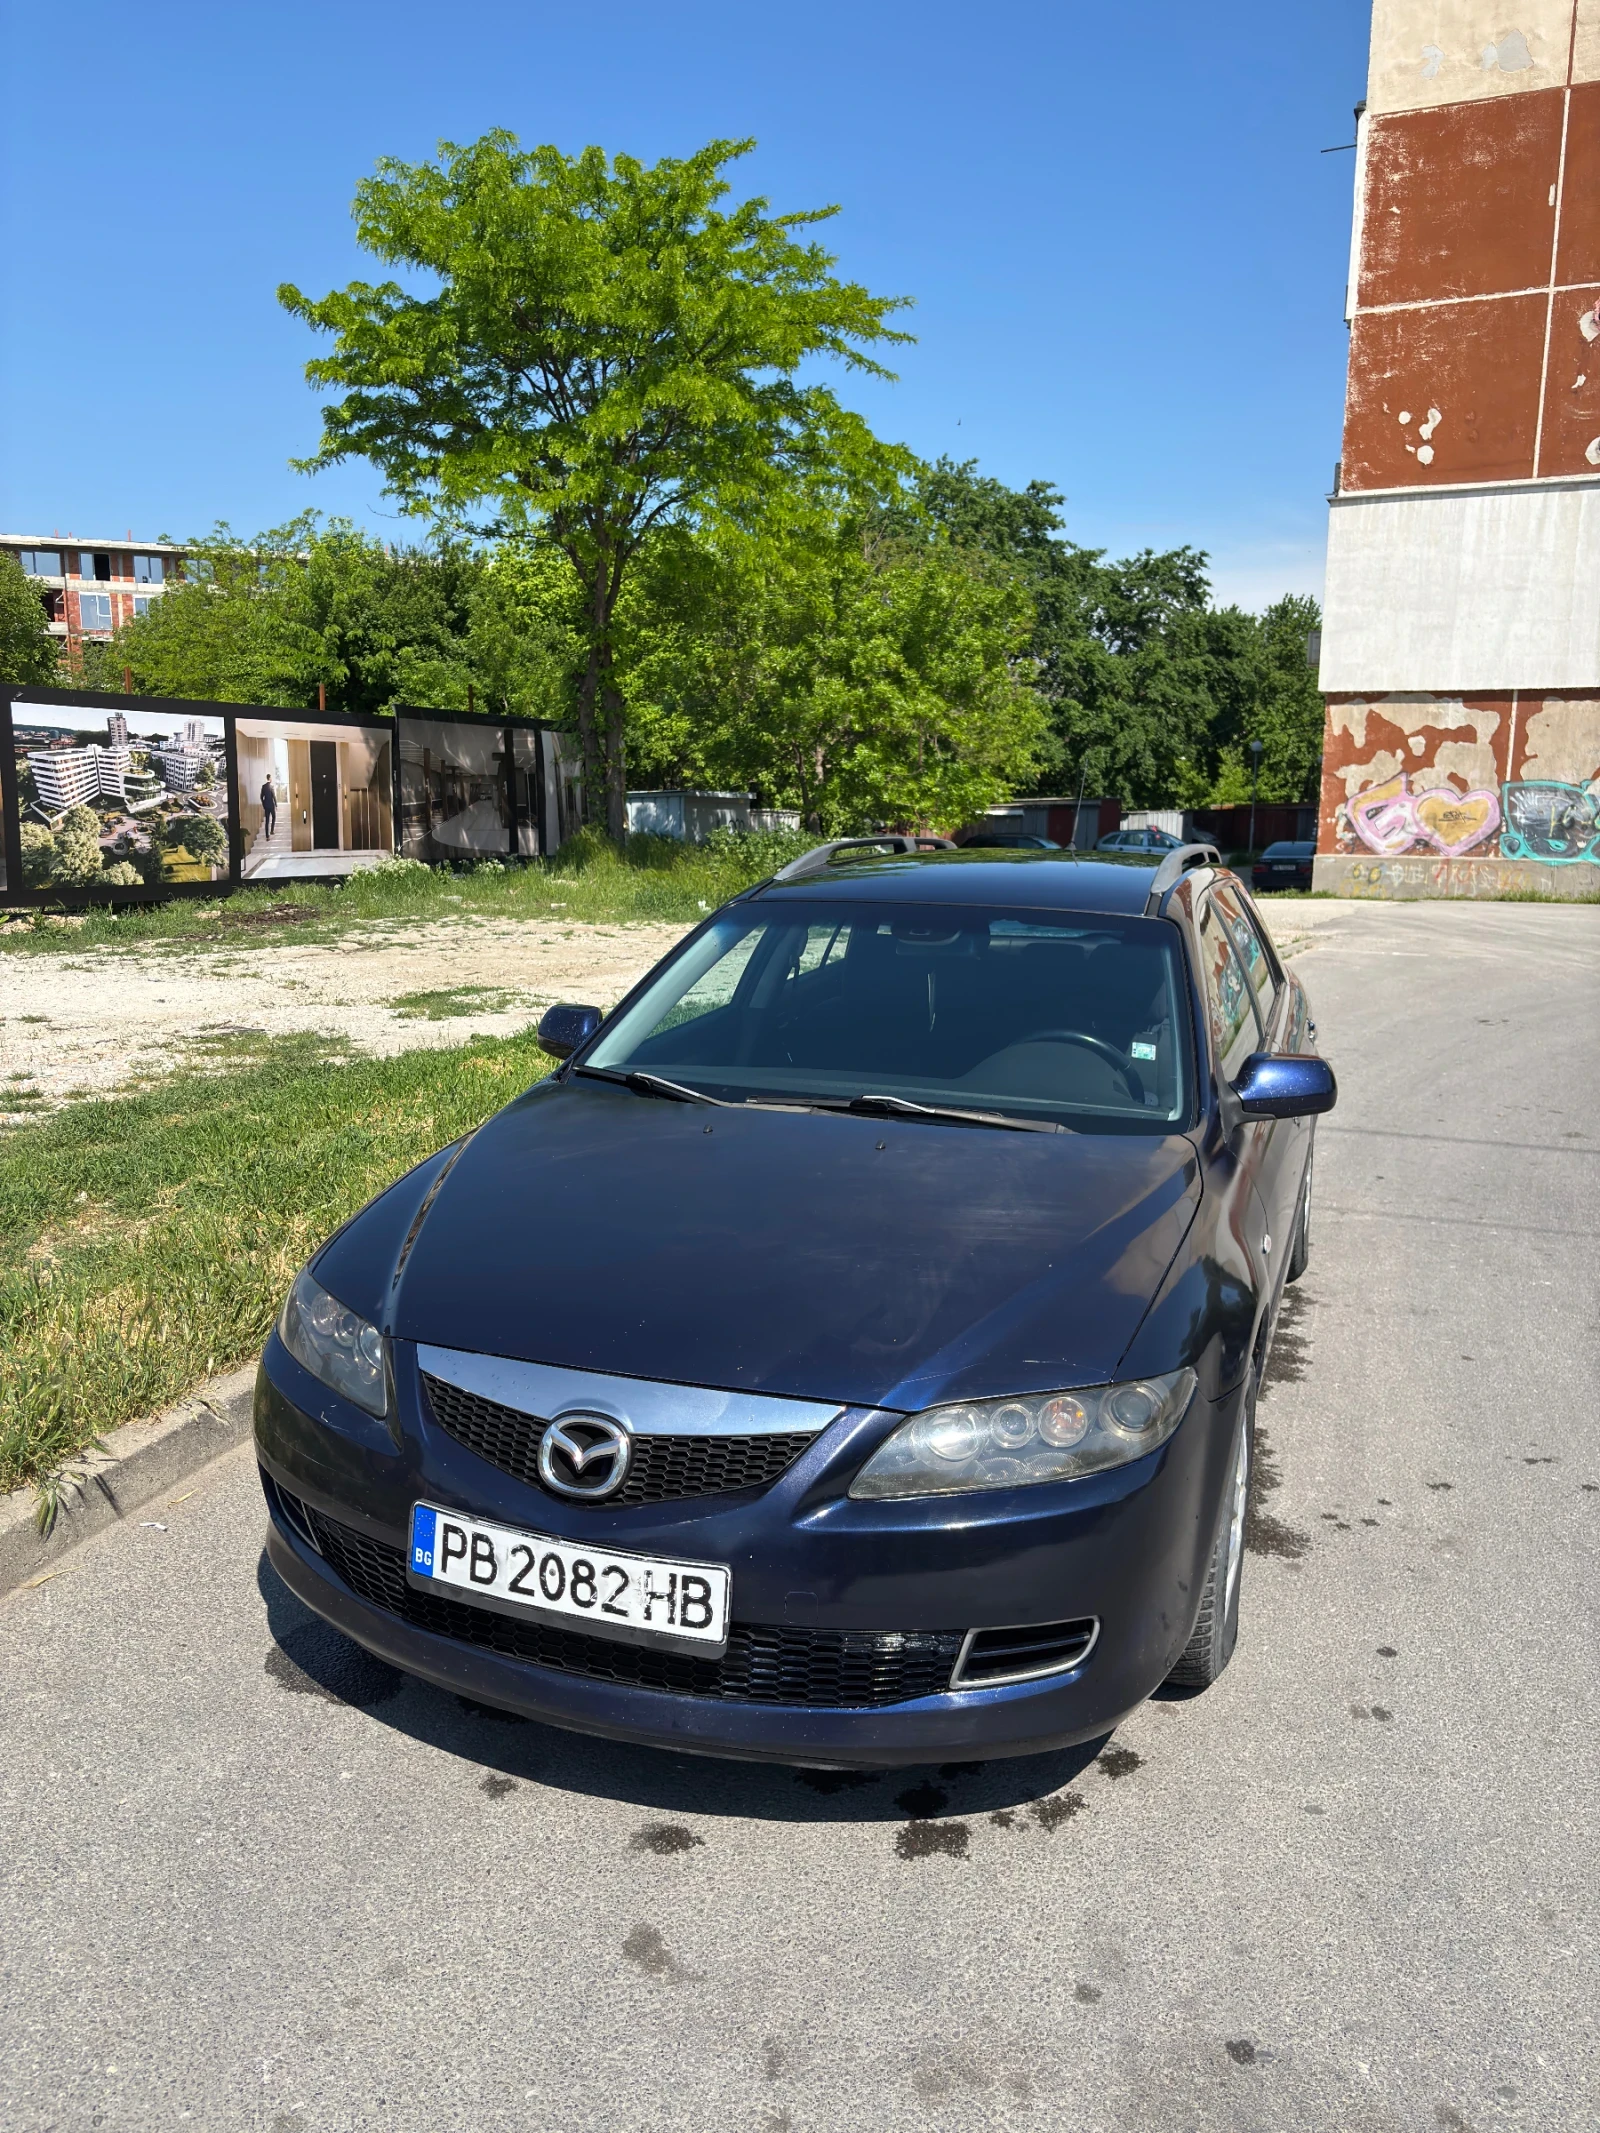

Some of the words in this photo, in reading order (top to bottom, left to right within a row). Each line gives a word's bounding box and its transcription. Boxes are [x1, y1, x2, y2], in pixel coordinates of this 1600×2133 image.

[415, 1547, 432, 1566] BG
[441, 1522, 498, 1586] PB
[508, 1544, 630, 1617] 2082
[643, 1569, 713, 1629] HB
